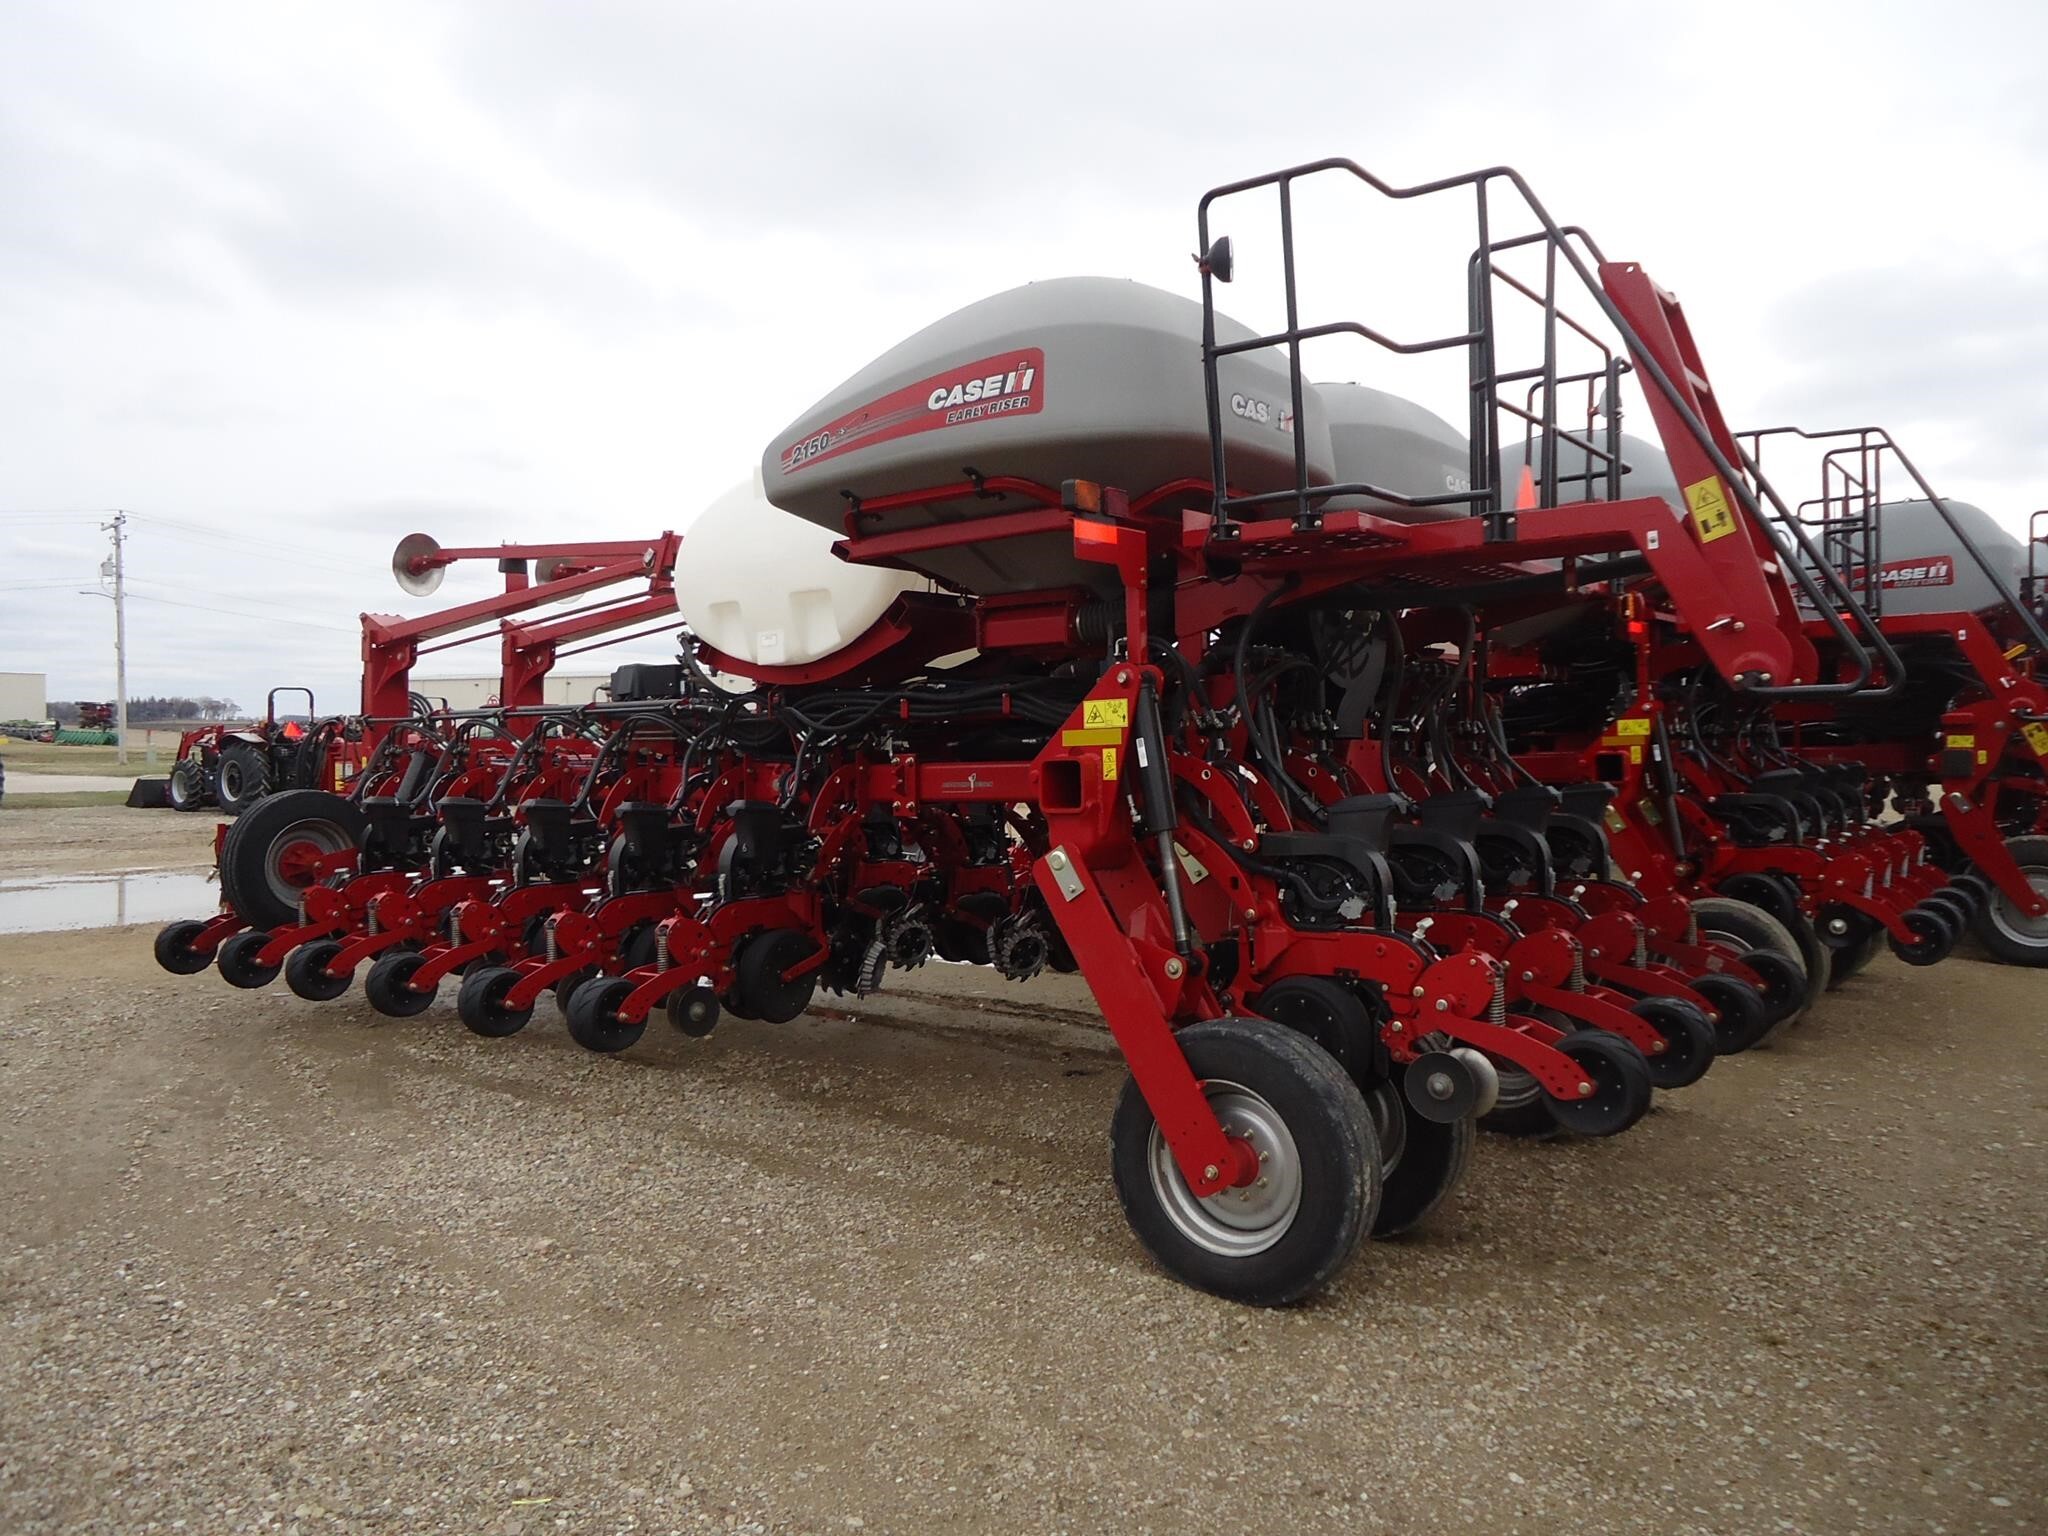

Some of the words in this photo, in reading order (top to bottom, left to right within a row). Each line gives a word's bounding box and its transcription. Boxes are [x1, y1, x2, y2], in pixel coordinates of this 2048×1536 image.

[928, 374, 1004, 411] CASE
[1231, 393, 1271, 424] CAS
[946, 403, 988, 425] EARLY
[988, 396, 1030, 415] RISER
[792, 431, 830, 465] 2150
